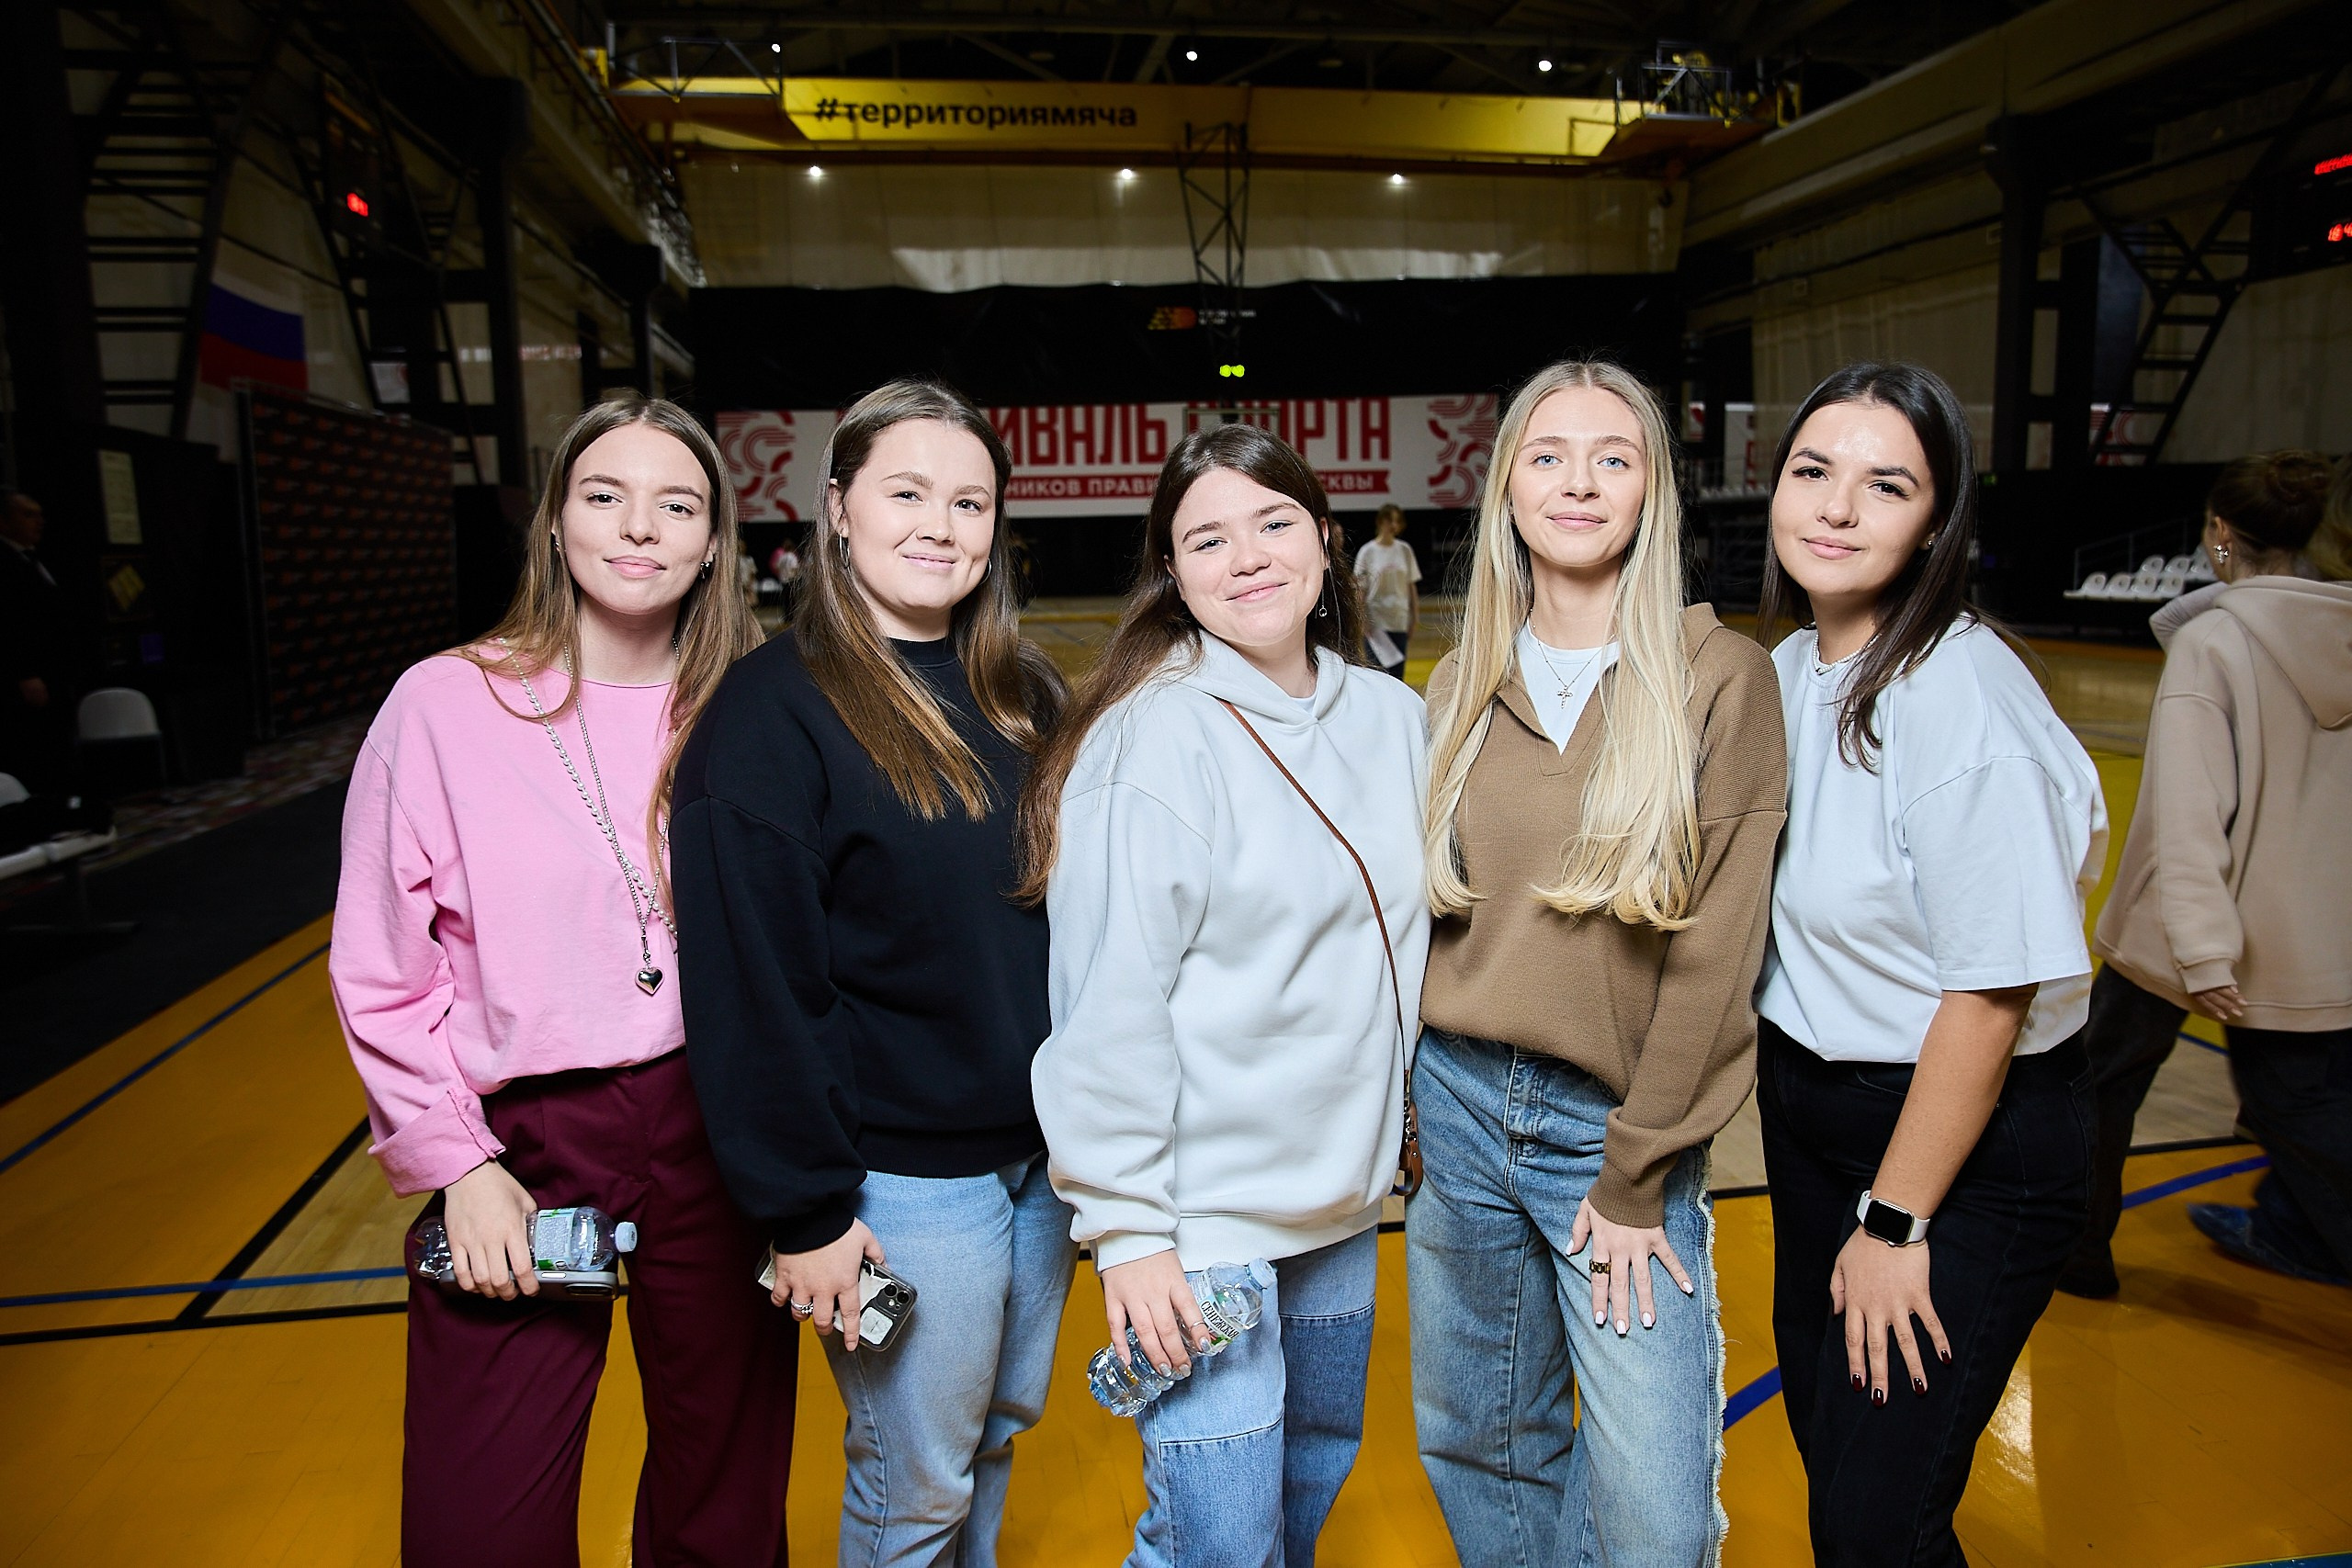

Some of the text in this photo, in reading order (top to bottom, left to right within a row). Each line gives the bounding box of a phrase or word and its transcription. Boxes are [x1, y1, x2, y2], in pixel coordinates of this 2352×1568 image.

[815, 97, 1136, 130] #территориямяча
[989, 402, 1167, 466] ИВАЛЬ
[1006, 479, 1081, 498] НИКОВ
[1200, 1301, 1239, 1339] СЕНЕЖСКАЯ
